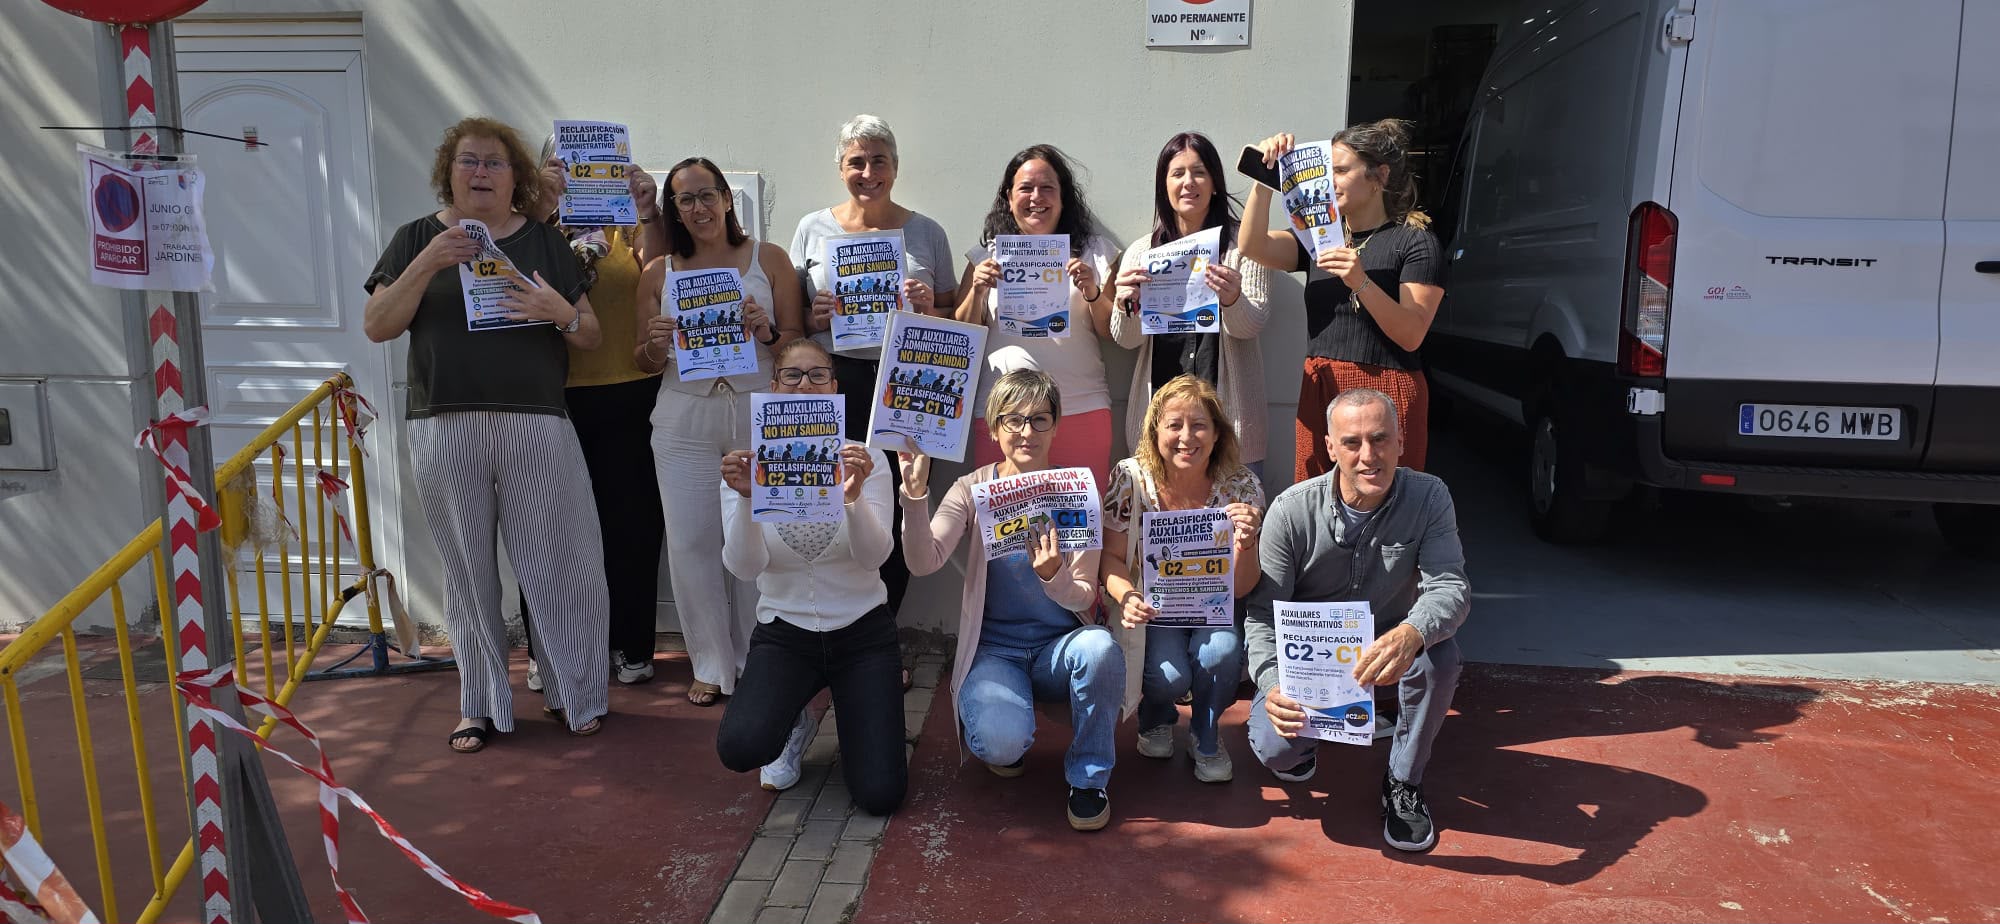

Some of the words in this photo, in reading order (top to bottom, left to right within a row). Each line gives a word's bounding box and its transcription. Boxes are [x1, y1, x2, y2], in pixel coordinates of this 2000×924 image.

[1151, 14, 1177, 23] VADO
[1180, 13, 1246, 22] PERMANENTE
[1190, 29, 1206, 40] Nº
[560, 125, 625, 134] RECLASIFICACIÓN
[560, 133, 615, 142] AUXILIARES
[615, 142, 628, 154] YA
[575, 165, 591, 177] C2
[610, 165, 624, 177] C1
[150, 204, 181, 214] JUNIO
[1318, 213, 1330, 224] YA
[97, 241, 141, 254] PROHIBIDO
[839, 246, 851, 257] SIN
[852, 243, 891, 255] AUXILIARES
[1149, 248, 1211, 259] RECLASIFICACIÓN
[100, 253, 136, 264] APARCAR
[839, 252, 893, 265] ADMINISTRATIVOS
[1766, 255, 1877, 267] TRANSIT
[479, 262, 497, 275] C2
[839, 265, 850, 276] NO
[851, 262, 865, 274] HAY
[867, 260, 896, 272] SANIDAD
[1148, 259, 1172, 275] C2
[678, 279, 691, 289] SIN
[693, 273, 732, 287] AUXILIARES
[1003, 269, 1026, 282] C2
[1042, 269, 1063, 283] C1
[680, 282, 736, 298] ADMINISTRATIVOS
[680, 298, 691, 310] NO
[692, 295, 708, 307] HAY
[709, 290, 740, 304] SANIDAD
[844, 302, 859, 314] C2
[872, 301, 884, 312] C1
[687, 325, 741, 337] RECLASIFICACIÓN
[906, 328, 920, 340] SIN
[922, 330, 967, 346] AUXILIARES
[688, 337, 704, 349] C2
[717, 333, 731, 344] C1
[733, 332, 745, 342] YA
[904, 340, 967, 356] ADMINISTRATIVOS
[900, 350, 912, 361] NO
[915, 352, 929, 363] HAY
[932, 355, 967, 368] SANIDAD
[896, 386, 955, 403] RECLASIFICACIÓN
[766, 404, 780, 415] SIN
[783, 401, 832, 413] AUXILIARES
[893, 395, 910, 409] C2
[925, 400, 940, 414] C1
[943, 405, 955, 417] YA
[766, 413, 834, 425] ADMINISTRATIVOS
[1759, 409, 1830, 433] 0646
[1840, 412, 1893, 436] MWB
[764, 426, 777, 438] NO
[780, 425, 797, 437] HAY
[799, 423, 837, 435] SANIDAD
[768, 463, 832, 472] RECLASIFICACIÓN
[768, 473, 785, 485] C2
[802, 472, 818, 485] C1
[821, 474, 834, 485] YA
[988, 470, 1078, 495] RECLASIFICACION
[988, 482, 1073, 508] ADMINISTRATIVA
[1075, 481, 1088, 491] YA
[993, 502, 1029, 519] AUXILIAR
[1031, 494, 1088, 505] ADMINISTRATIVO
[999, 518, 1025, 536] C2
[1057, 511, 1083, 527] C1
[1150, 510, 1227, 527] RECLASIFICACIÓN
[1071, 527, 1094, 538] GESTIÓN
[1149, 523, 1213, 537] AUXILIARES
[991, 541, 1002, 550] NO
[1003, 533, 1025, 544] SOMOS
[1150, 533, 1213, 544] ADMINISTRATIVOS
[1214, 529, 1229, 547] YA
[1164, 562, 1183, 576] C2
[1205, 559, 1222, 574] C1
[1280, 609, 1320, 618] AUXILIARES
[1281, 619, 1342, 628] ADMINISTRATIVOS
[1283, 633, 1362, 643] RECLASIFICACIÓN
[1284, 643, 1313, 661] C2
[1336, 645, 1361, 663] C1
